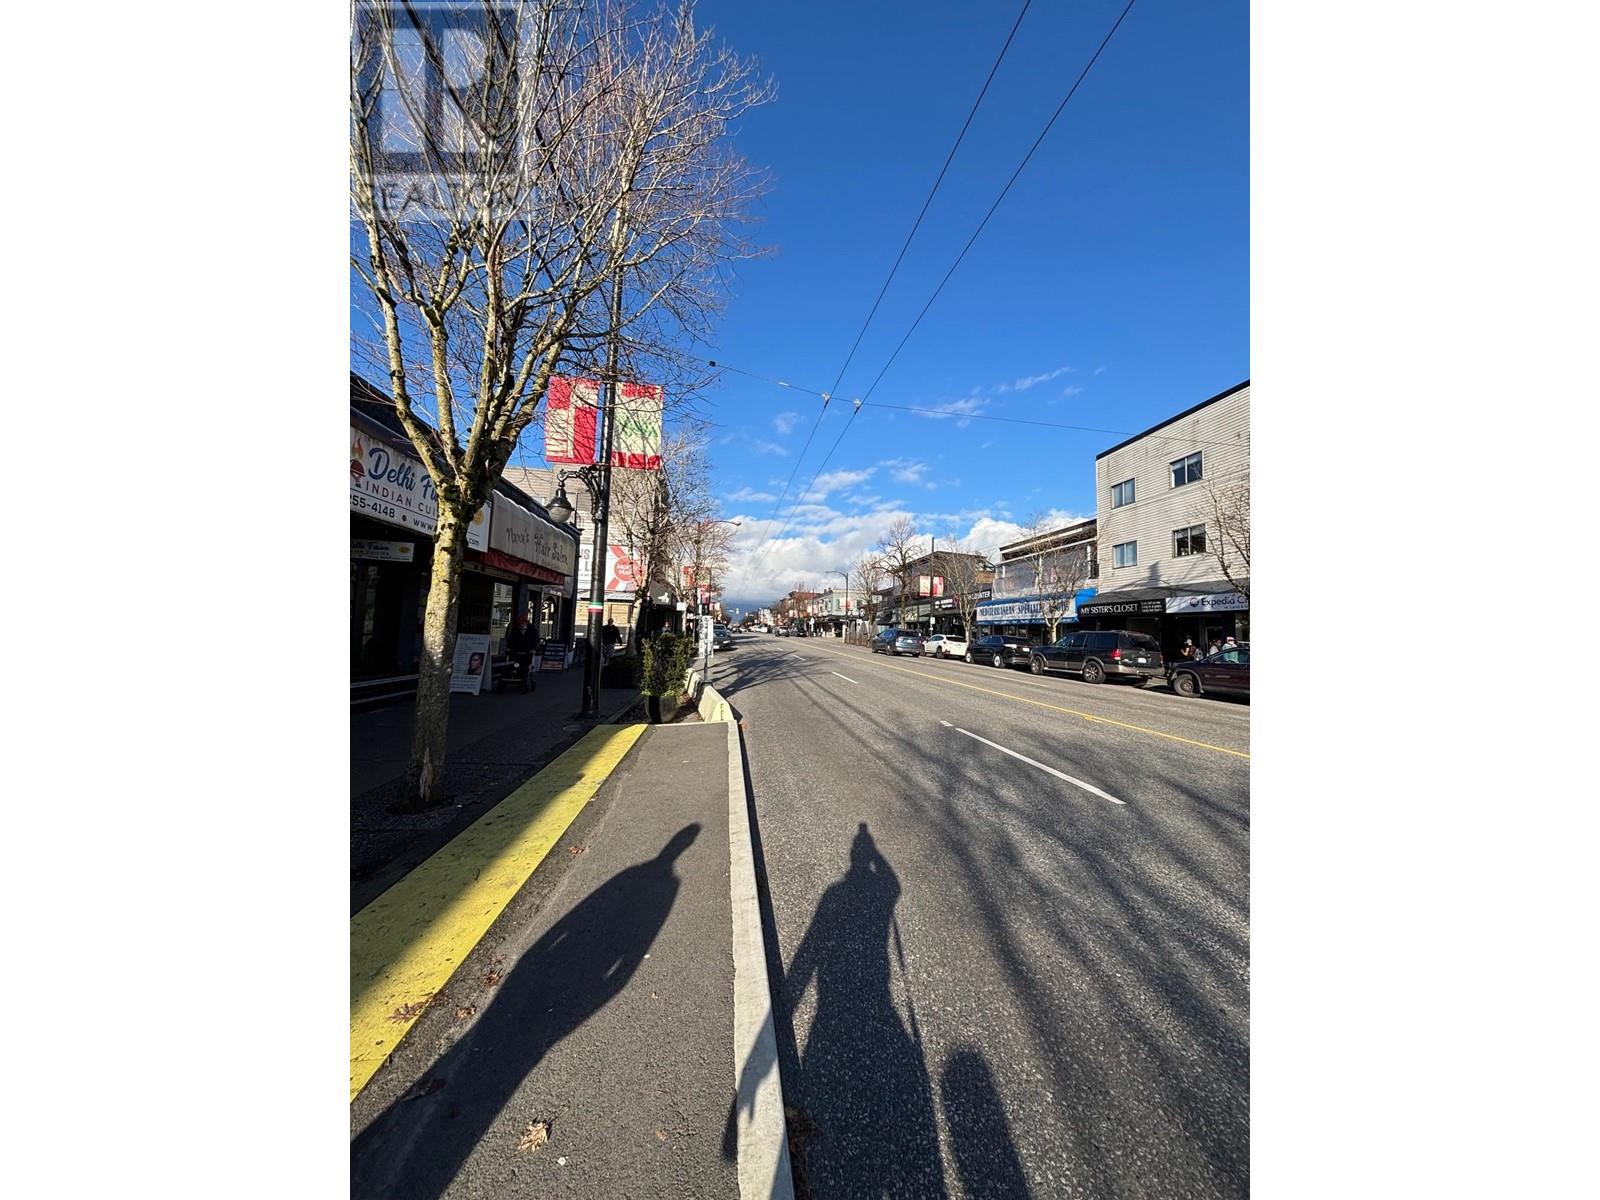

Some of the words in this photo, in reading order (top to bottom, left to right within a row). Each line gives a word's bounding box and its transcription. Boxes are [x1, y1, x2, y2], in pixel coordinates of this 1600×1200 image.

[368, 447, 416, 491] Delhi
[366, 481, 412, 507] INDIAN
[1090, 605, 1113, 614] SISTER'S
[1113, 603, 1138, 612] CLOSET
[1201, 596, 1236, 608] Expedia
